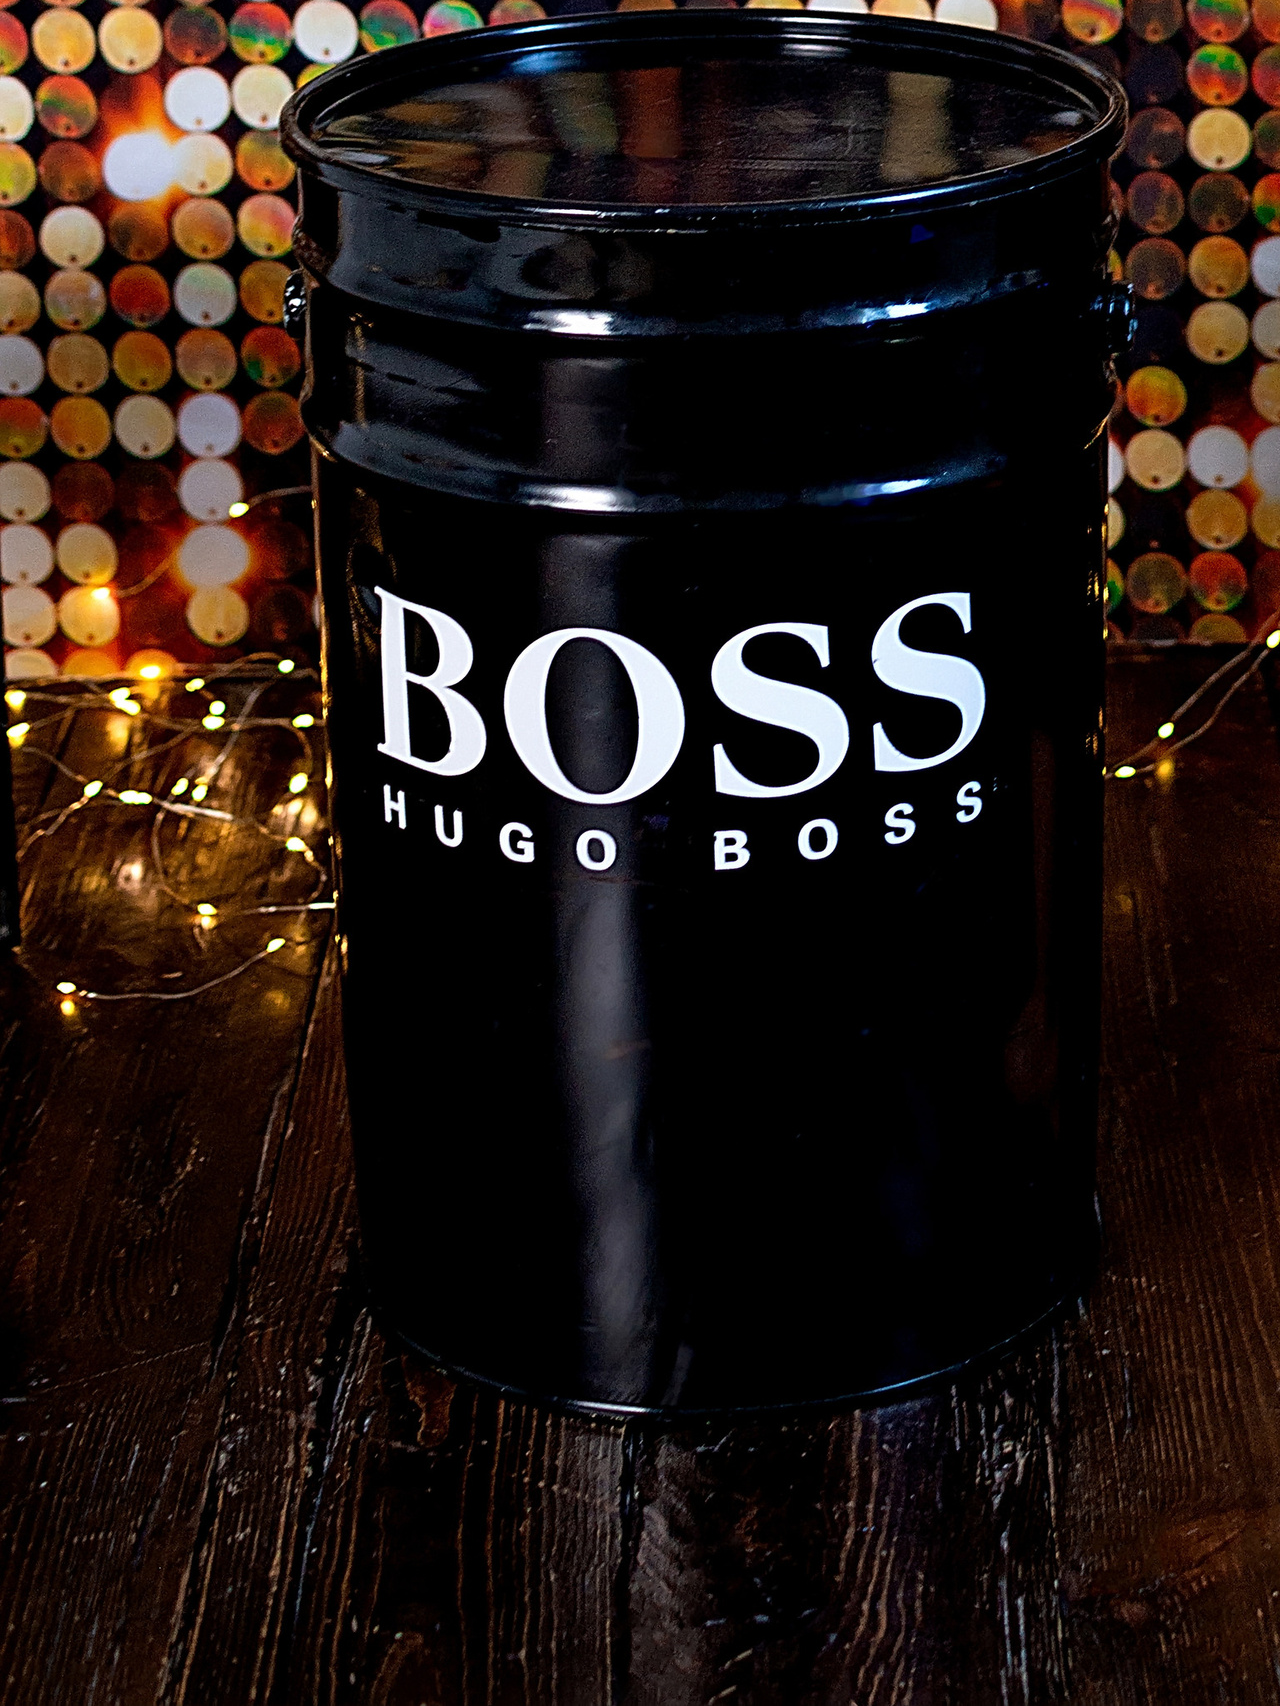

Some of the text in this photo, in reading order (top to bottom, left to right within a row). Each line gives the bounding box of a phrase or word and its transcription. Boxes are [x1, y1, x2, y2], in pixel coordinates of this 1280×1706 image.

[374, 586, 986, 804] BOSS
[383, 781, 982, 871] HUGO BOSS
